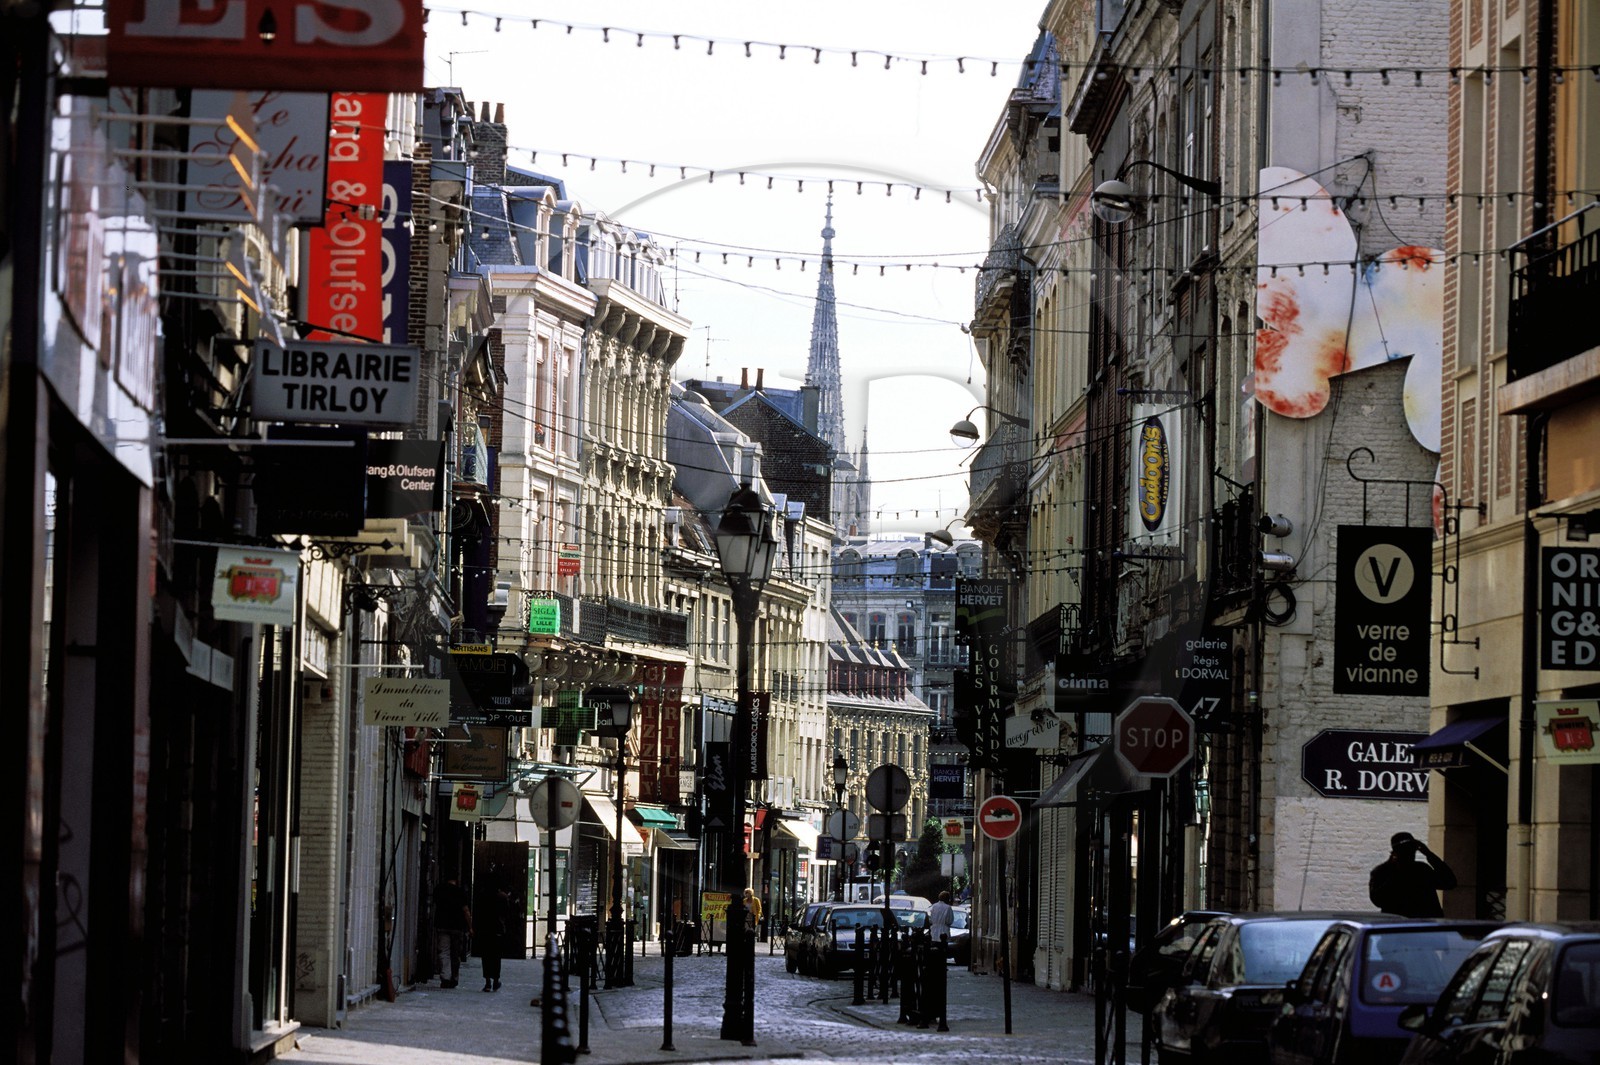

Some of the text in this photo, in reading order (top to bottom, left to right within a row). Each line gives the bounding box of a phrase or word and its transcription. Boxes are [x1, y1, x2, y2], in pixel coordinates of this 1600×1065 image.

[330, 92, 363, 162] ang
[329, 222, 367, 341] Olufse
[262, 349, 411, 382] LIBRAIRIE
[282, 383, 389, 414] TIRLOY
[400, 478, 435, 491] Center
[1369, 557, 1400, 597] V
[959, 584, 1004, 595] BANQUE
[1552, 582, 1600, 607] NI
[959, 595, 1004, 606] HERVET
[1356, 624, 1410, 641] verre
[1185, 636, 1228, 651] galerie
[1369, 642, 1397, 662] de
[1058, 672, 1109, 689] cinna
[1181, 667, 1230, 680] DORVAL
[1345, 663, 1418, 684] vianne
[399, 699, 414, 708] du
[974, 650, 984, 757] LES VINS
[374, 710, 406, 721] Vieux
[642, 667, 659, 796] GRIZZLY
[663, 688, 679, 778] GRILL
[1126, 727, 1184, 750] STOP
[933, 775, 960, 783] HERVET
[1324, 769, 1430, 793] R. DORV
